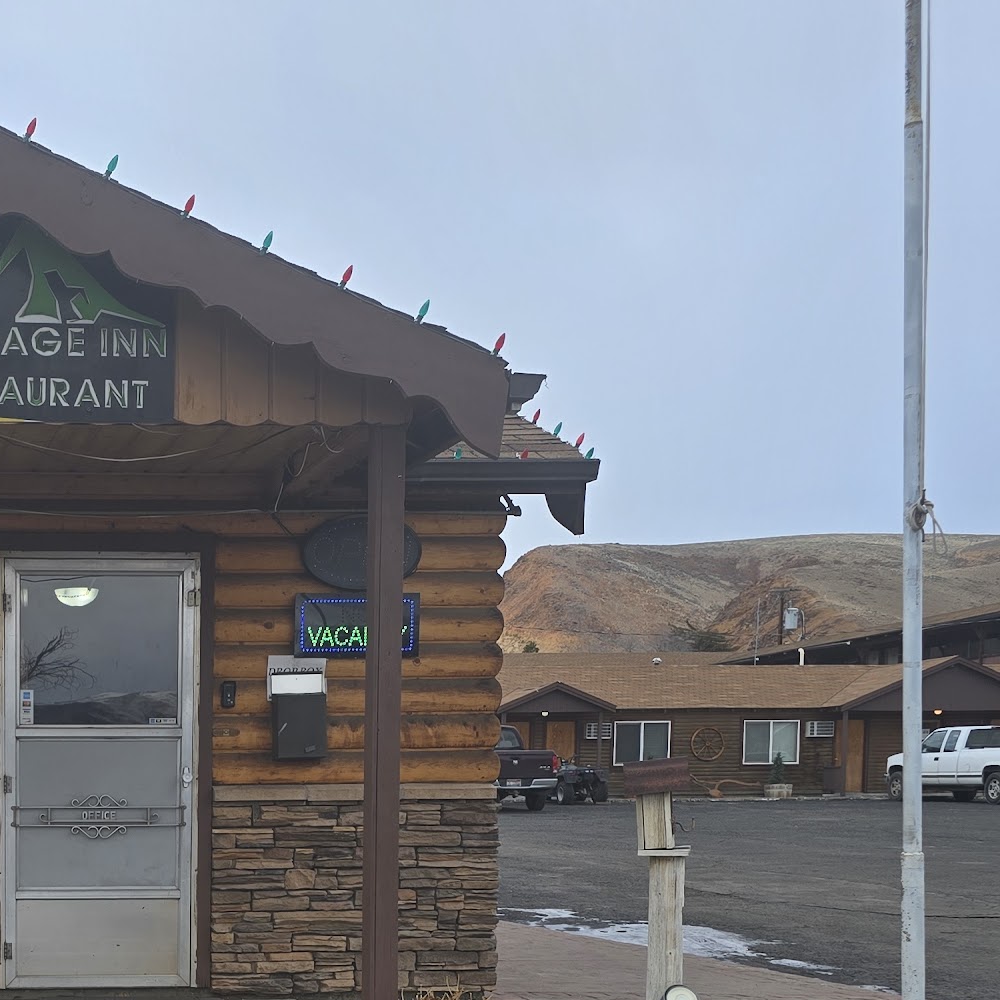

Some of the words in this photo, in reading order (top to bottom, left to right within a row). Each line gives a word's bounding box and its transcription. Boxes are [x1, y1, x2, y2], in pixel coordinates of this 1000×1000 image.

[101, 328, 167, 358] INN
[307, 626, 408, 647] VACA
[82, 811, 116, 820] OFFICE
